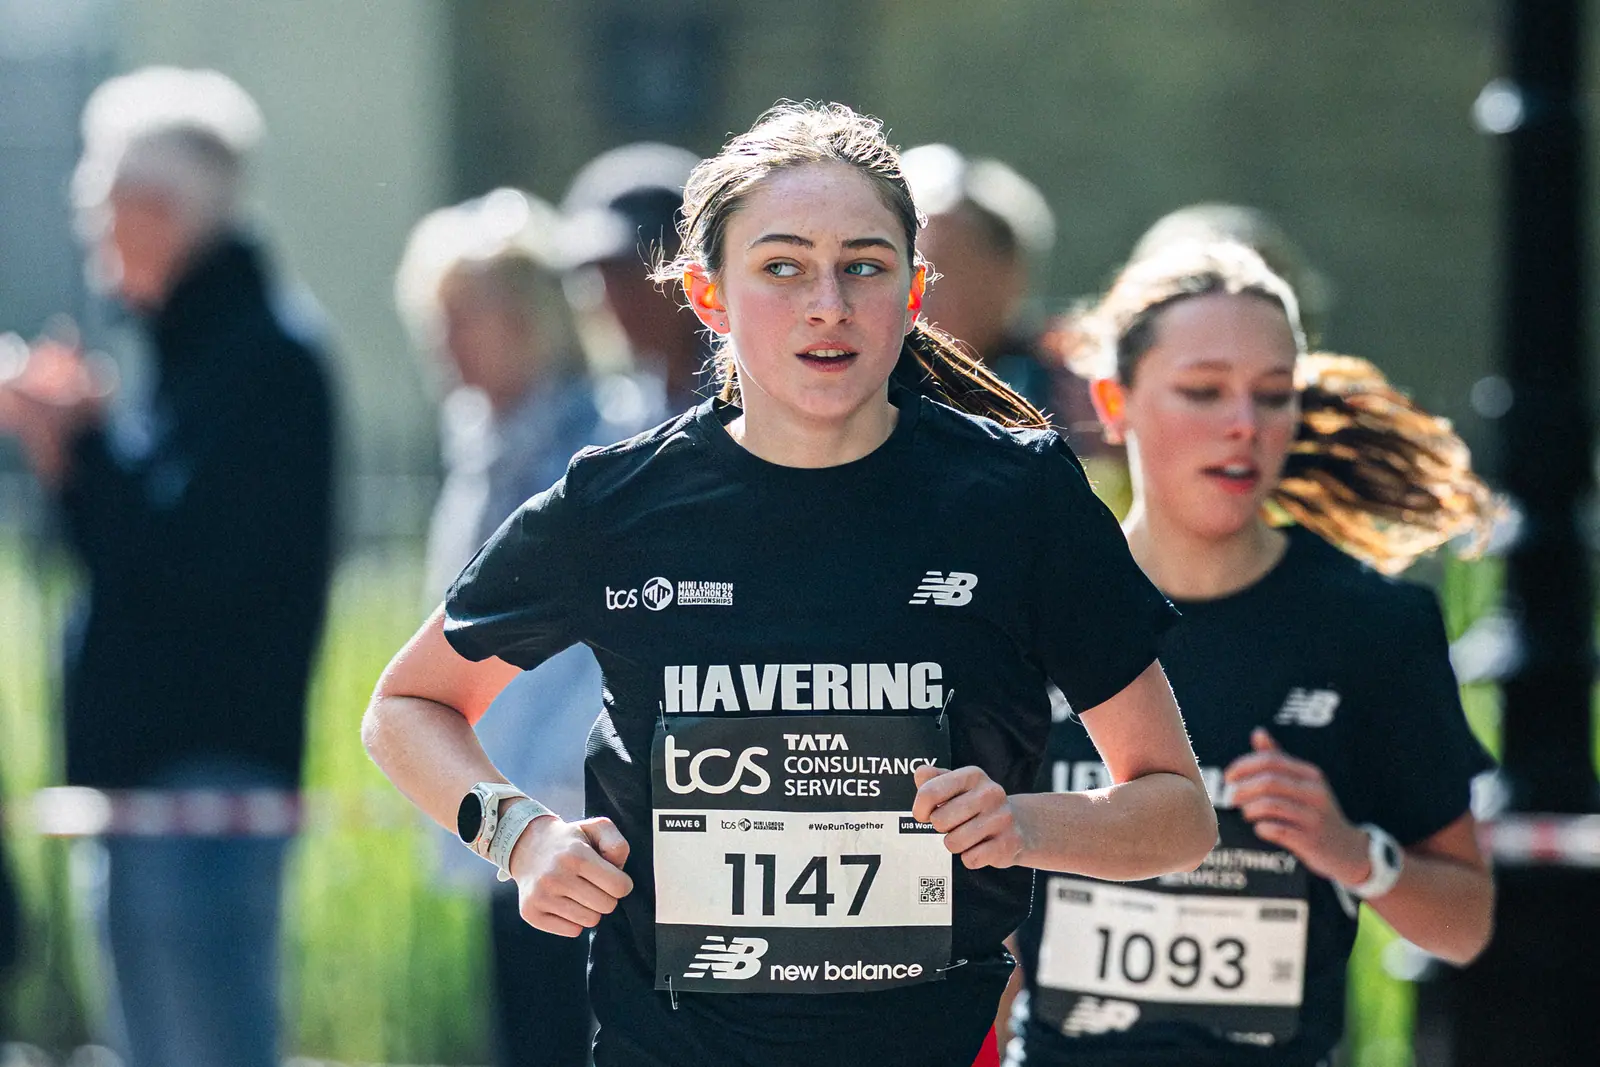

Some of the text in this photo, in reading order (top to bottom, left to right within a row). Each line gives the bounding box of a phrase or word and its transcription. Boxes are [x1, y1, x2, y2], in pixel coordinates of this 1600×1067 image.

[677, 581, 734, 591] MINI LONDON
[677, 589, 720, 598] MARATHON
[908, 570, 979, 607] NB
[605, 585, 638, 610] tcs
[678, 597, 733, 605] CHAMPIONSHIPS
[664, 661, 943, 713] HAVERING
[782, 733, 849, 751] TATA
[665, 734, 771, 795] tcs
[784, 778, 881, 797] SERVICES
[665, 819, 700, 828] WAVE 6
[721, 819, 737, 830] tcs
[808, 822, 884, 831] #WeRunTogether
[901, 821, 914, 830] U18
[724, 853, 882, 917] 1147
[682, 935, 769, 980] NB
[1096, 925, 1247, 990] 1093
[770, 960, 923, 981] new balance
